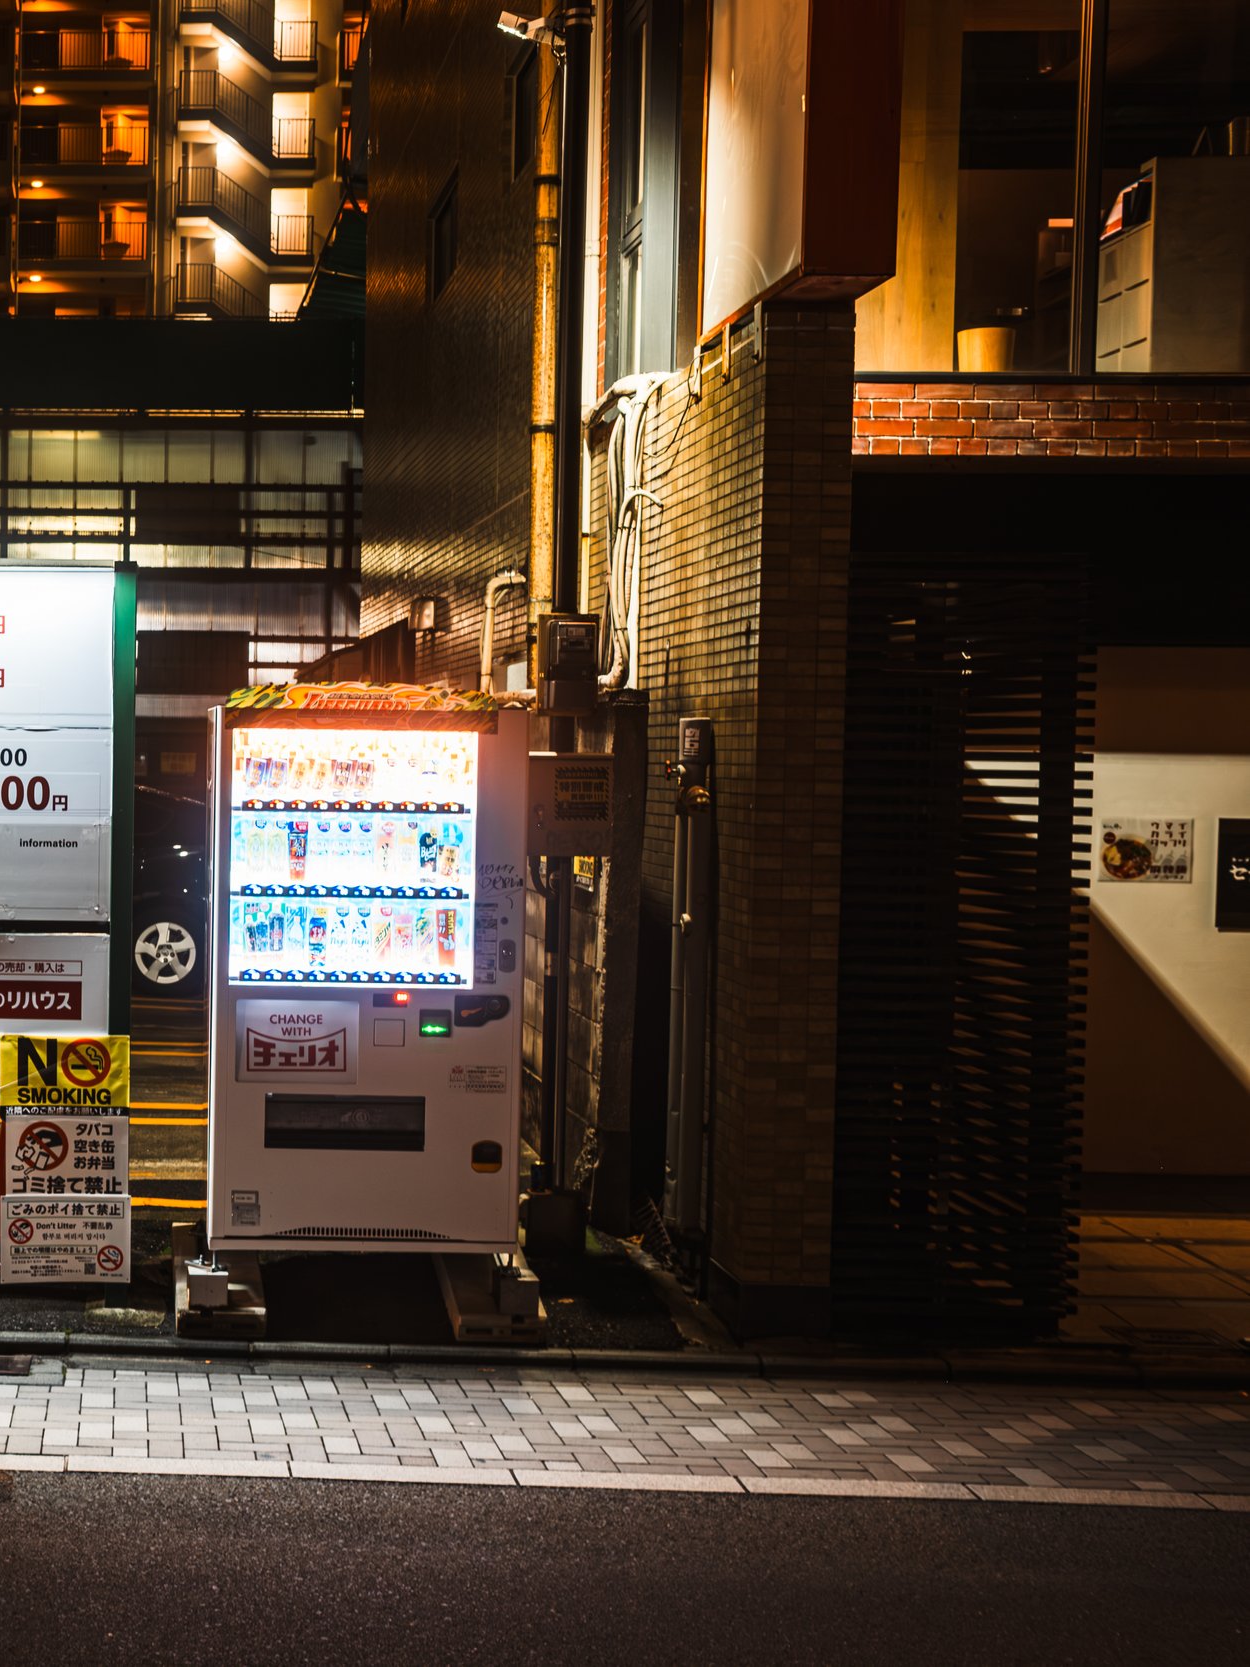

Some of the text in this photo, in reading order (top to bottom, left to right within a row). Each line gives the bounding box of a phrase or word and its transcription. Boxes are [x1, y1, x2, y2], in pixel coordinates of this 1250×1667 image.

[19, 837, 79, 849] Information
[269, 1013, 323, 1026] CHANGE
[281, 1026, 312, 1037] WITH
[253, 1036, 340, 1067] チェリオ
[17, 1087, 112, 1106] SMOKING
[75, 1122, 113, 1136] タバコ
[73, 1138, 115, 1154] 空き缶
[73, 1156, 116, 1171] お弁当
[12, 1175, 123, 1195] ゴミ捨て禁止
[11, 1203, 122, 1217] ごみのポイ捨て禁止
[36, 1222, 76, 1230] Don't Litter
